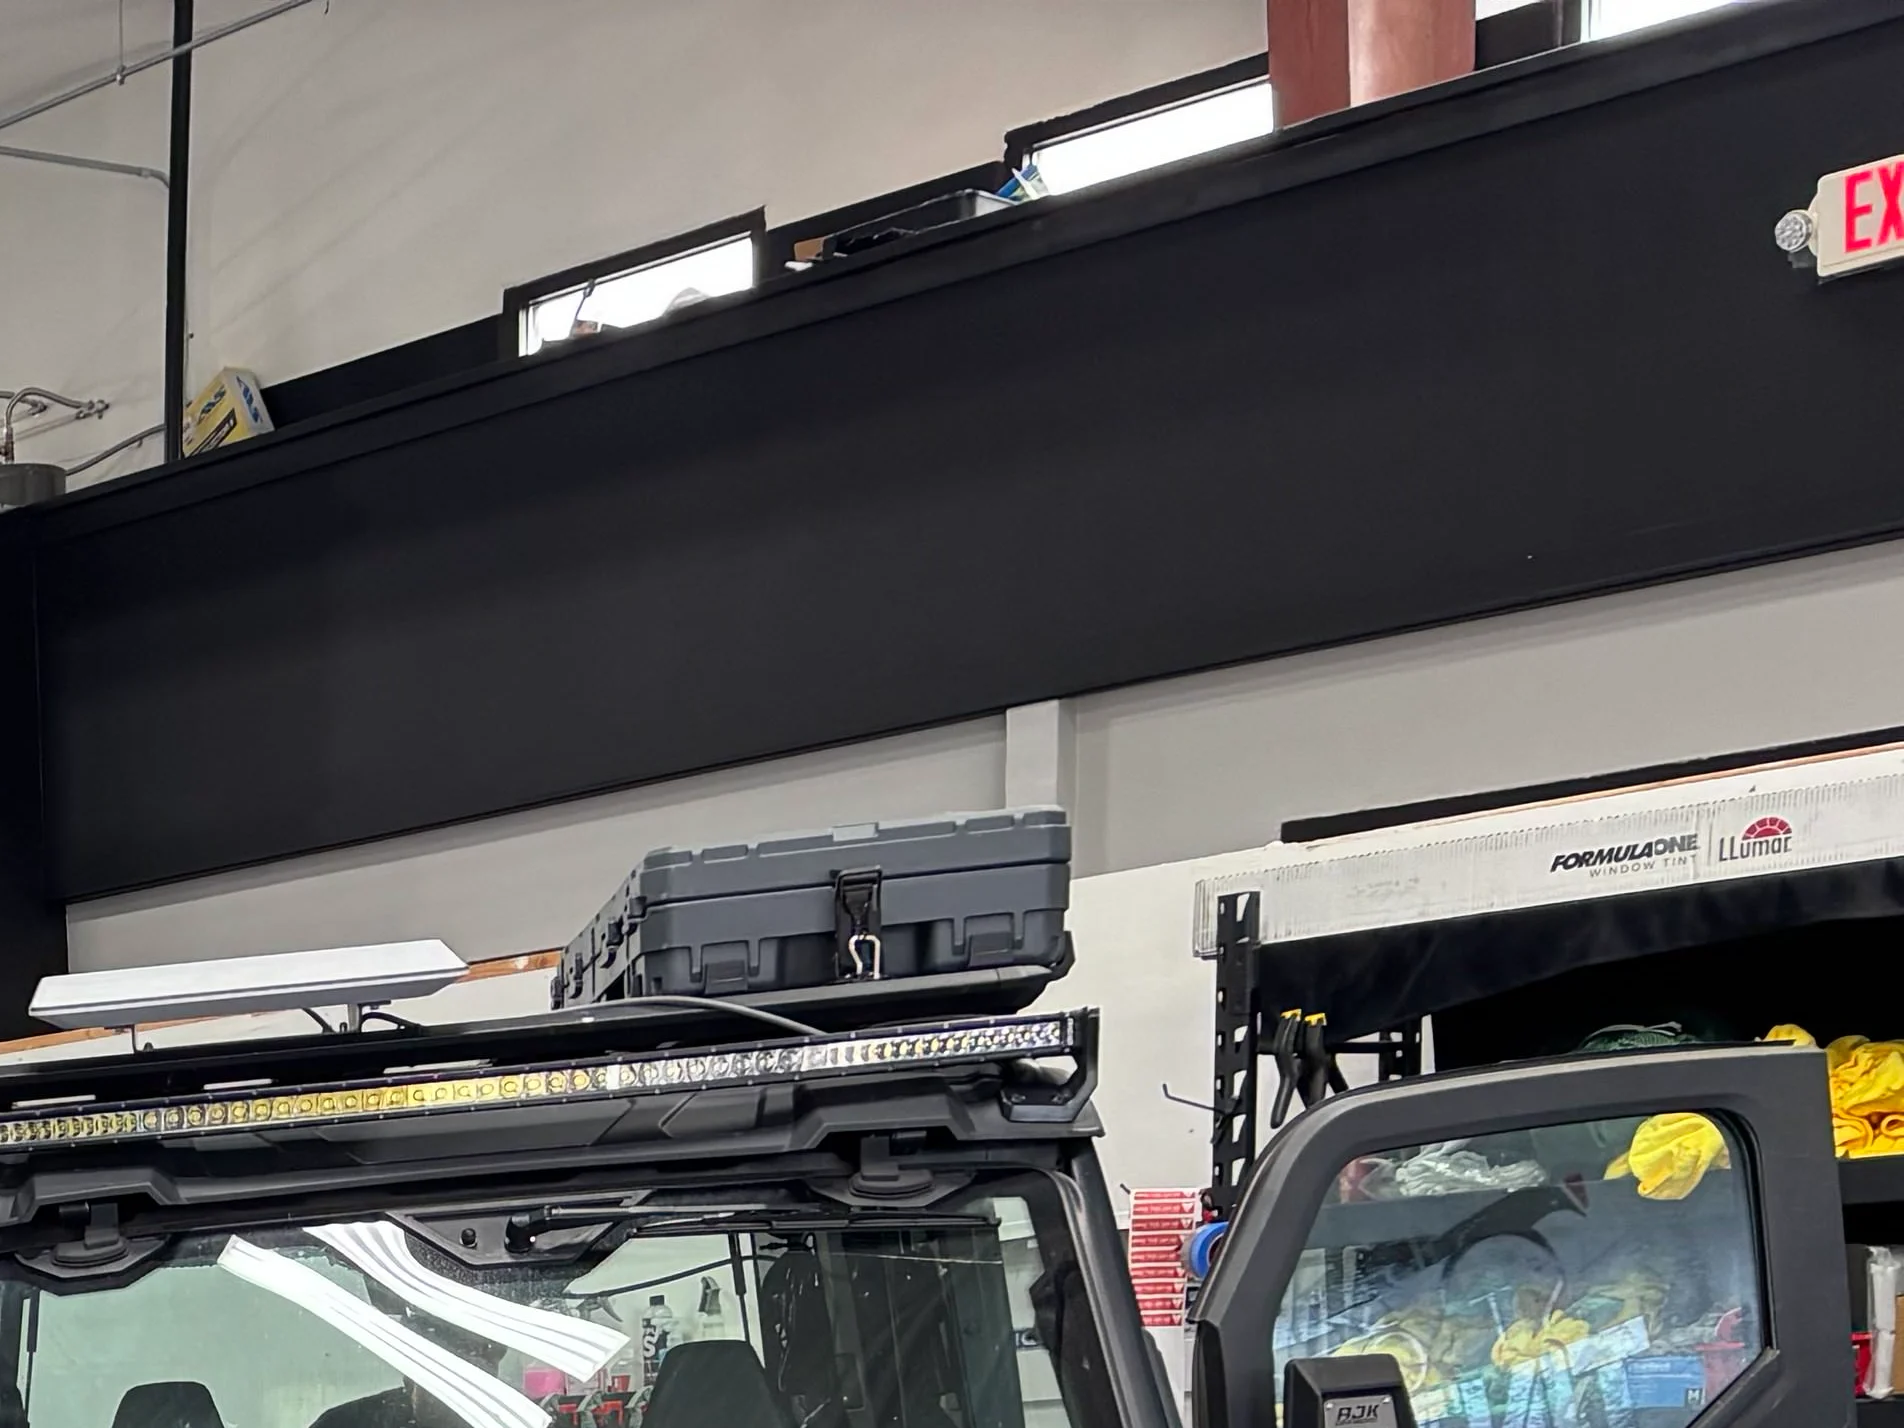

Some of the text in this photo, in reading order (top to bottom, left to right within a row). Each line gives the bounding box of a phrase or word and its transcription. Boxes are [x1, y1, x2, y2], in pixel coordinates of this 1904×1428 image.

[1589, 854, 1697, 878] WINDOW TINT
[1337, 1404, 1379, 1420] AJK
